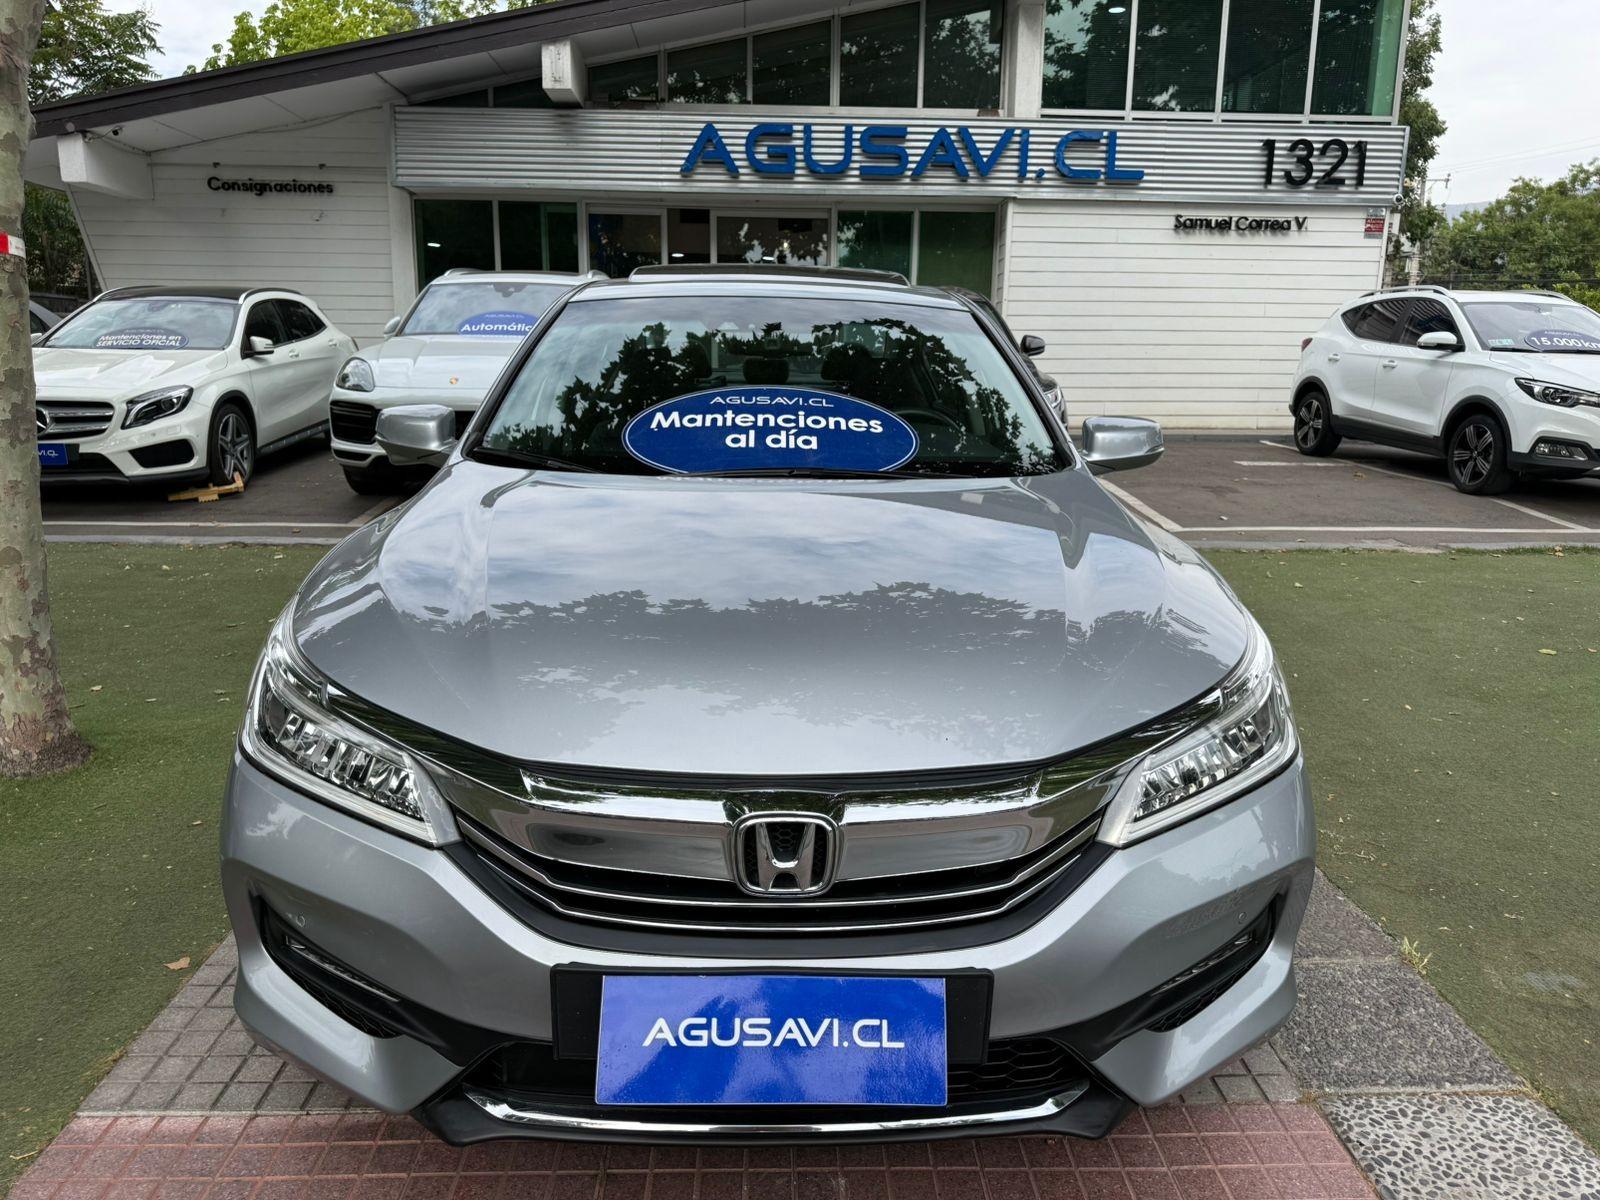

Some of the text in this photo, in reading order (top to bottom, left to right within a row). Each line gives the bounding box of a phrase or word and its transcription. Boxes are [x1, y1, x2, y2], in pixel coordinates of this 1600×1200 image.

[680, 122, 1145, 184] AGUSAVI.CL
[1262, 138, 1368, 188] 1321
[207, 176, 334, 196] Consignaciones
[1174, 214, 1232, 231] Samuel
[1235, 216, 1291, 231] Correa
[461, 322, 532, 332] Automátic
[709, 396, 834, 407] AGUSAVI.CL
[650, 410, 883, 433] Mantenciones
[725, 429, 818, 450] al día
[642, 1017, 906, 1049] AGUSAVI.CL
